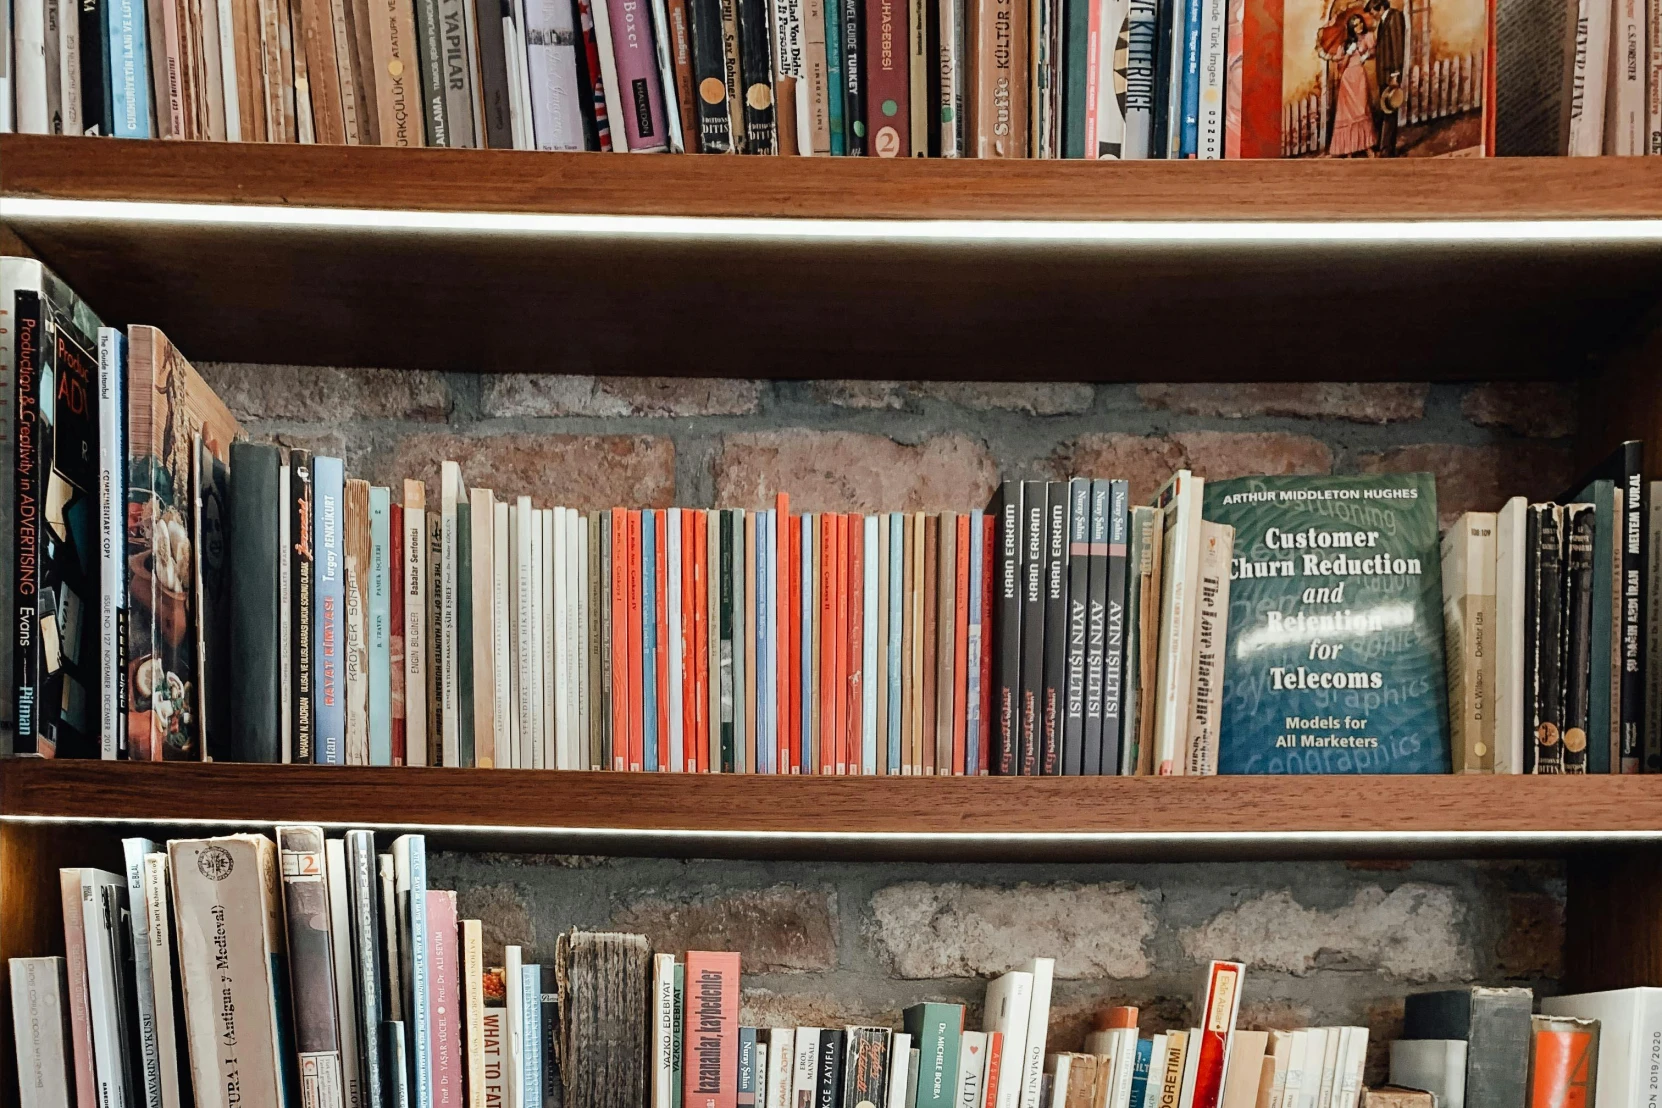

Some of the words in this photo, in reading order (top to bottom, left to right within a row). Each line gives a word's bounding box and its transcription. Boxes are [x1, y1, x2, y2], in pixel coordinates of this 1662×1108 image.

[623, 1, 639, 49] Boxer
[847, 23, 857, 50] GUIDE
[995, 11, 1009, 69] KÜLTÜR
[1210, 25, 1220, 48] Türk
[445, 12, 464, 90] YAPILAR
[1125, 20, 1156, 115] KITTERIDGE
[1207, 53, 1220, 86] İmgesi
[725, 57, 737, 99] Rohmer
[848, 53, 858, 95] TURKEY
[635, 81, 650, 135] KHALKEDON
[994, 77, 1009, 136] Suffe
[19, 319, 36, 391] Production
[19, 396, 35, 404] &
[101, 372, 109, 399] Istanbul
[17, 411, 35, 473] Creativity
[20, 479, 35, 490] in
[102, 470, 111, 536] COMPLIMENTARY
[1075, 491, 1087, 515] Nuray
[1222, 491, 1277, 505] ARTHUR
[1279, 490, 1361, 501] MIDDLETON
[1363, 488, 1418, 500] HUGHES
[19, 494, 36, 595] ADVERTISING
[409, 528, 418, 563] Senfonisi
[1074, 517, 1086, 540] Şahin
[1265, 527, 1379, 549] Customer
[410, 566, 418, 595] Babalar
[1229, 556, 1295, 581] Churn
[1302, 554, 1422, 576] Reduction
[1302, 582, 1345, 604] and
[19, 607, 34, 646] Evans
[1071, 600, 1085, 645] AYIN
[1266, 611, 1383, 633] Retention
[1308, 639, 1344, 660] for
[1068, 649, 1084, 719] IŞILTISI
[1270, 667, 1383, 689] Telecoms
[19, 687, 34, 735] Pitman
[1285, 716, 1341, 729] Models
[1344, 716, 1367, 729] for
[1276, 735, 1297, 748] All
[1301, 735, 1378, 748] Marketers
[210, 904, 229, 970] Medieval)
[360, 850, 376, 1007] HYPERGRAPHICS
[221, 975, 233, 983] y
[142, 1012, 155, 1055] UYKUSU
[221, 988, 238, 1047] (Antigua
[483, 1014, 501, 1056] WHAT
[938, 1022, 947, 1035] Dr.
[485, 1061, 501, 1079] TO
[824, 1041, 835, 1092] ZAYIFLA
[935, 1035, 945, 1070] MICHELE
[1030, 1046, 1041, 1093] OSMANLI
[1649, 1030, 1662, 1091] 2019/2020
[932, 1071, 943, 1099] BORBA
